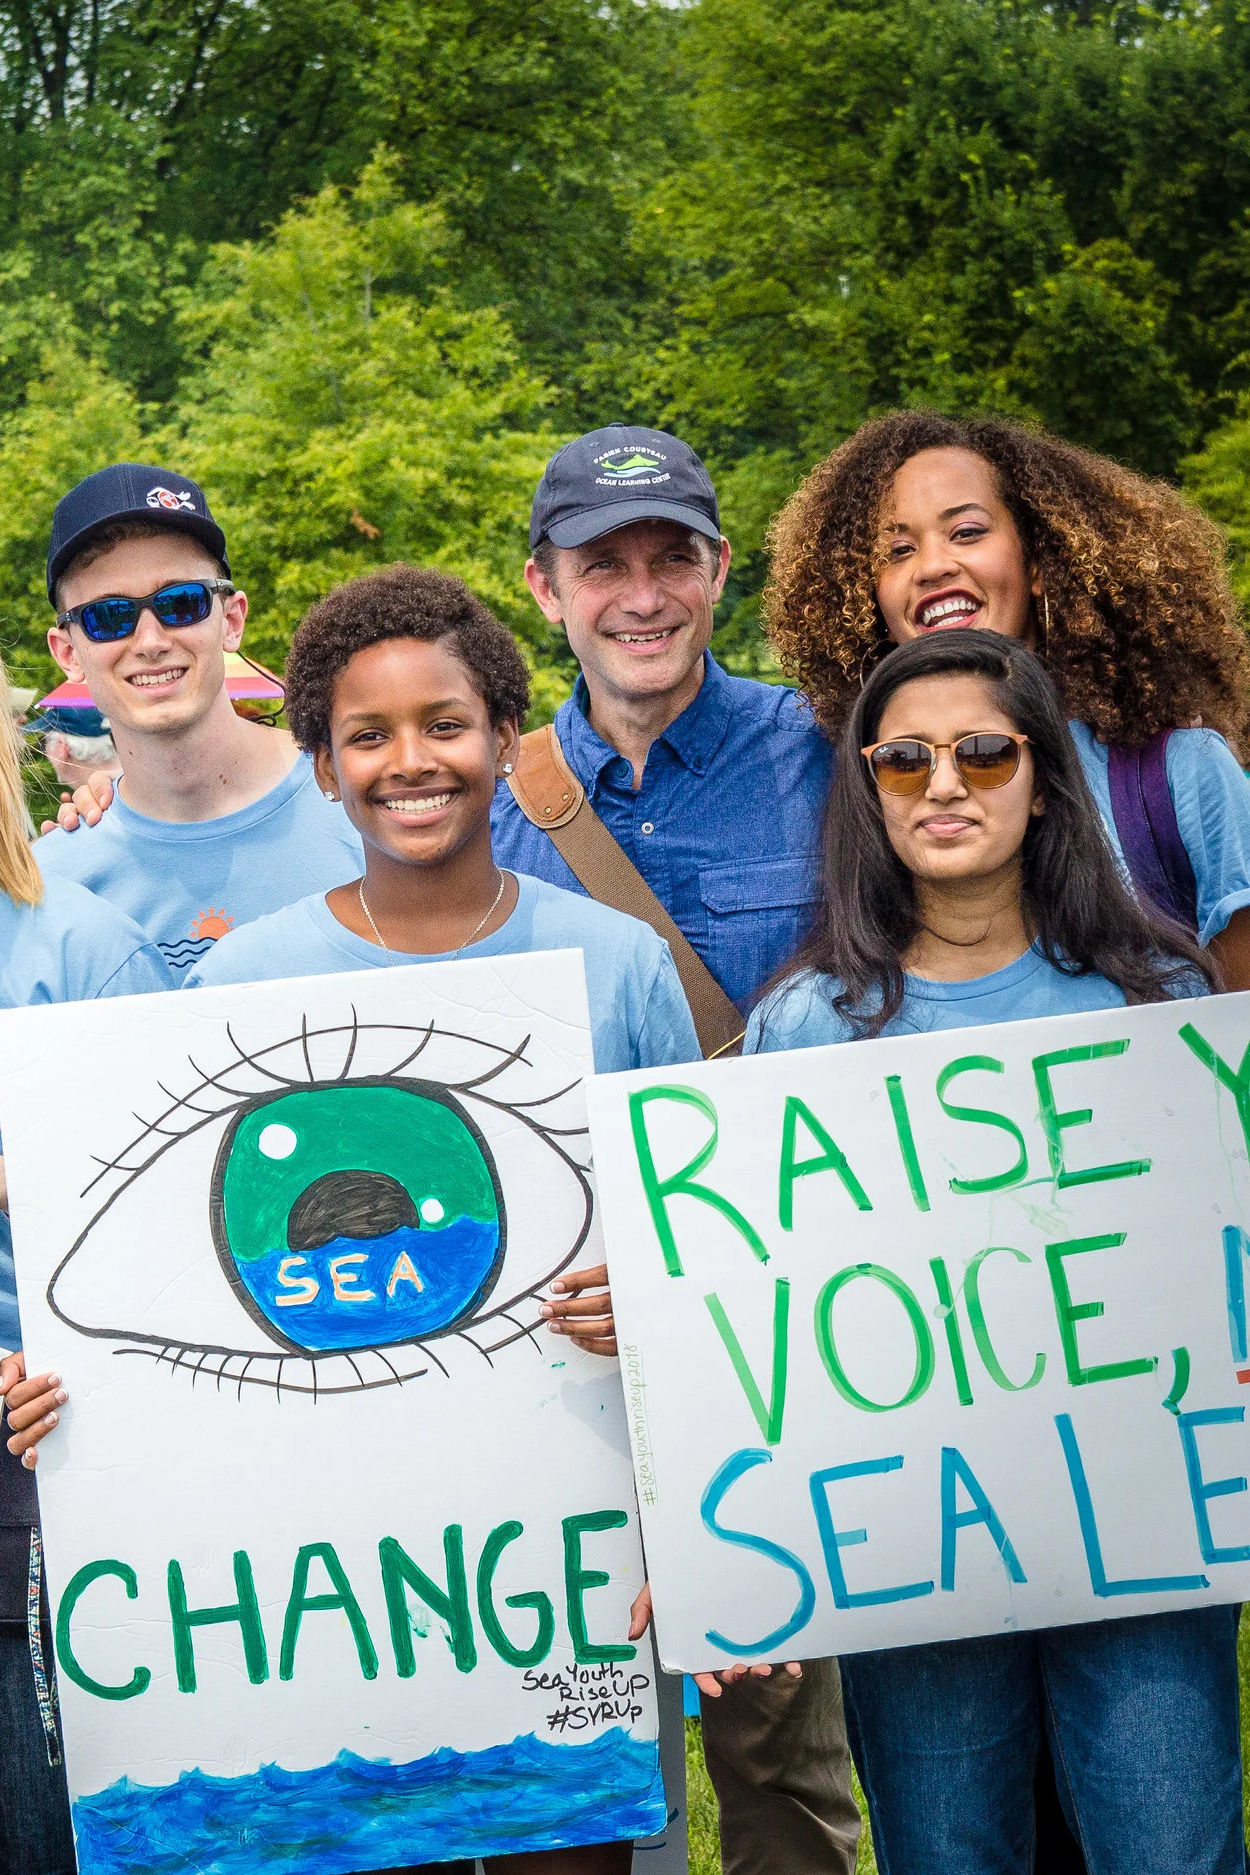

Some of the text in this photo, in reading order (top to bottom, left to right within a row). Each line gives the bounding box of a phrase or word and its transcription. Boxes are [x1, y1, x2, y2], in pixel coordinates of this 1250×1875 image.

[595, 477, 617, 486] OCEAN
[618, 478, 651, 486] LEARNING
[629, 1038, 1152, 1277] RAISE
[274, 1251, 425, 1307] SEA
[703, 1232, 1190, 1446] VOICE,
[56, 1508, 637, 1701] CHANGE
[700, 1446, 1028, 1655] SEA
[521, 1661, 623, 1691] Sea Youth
